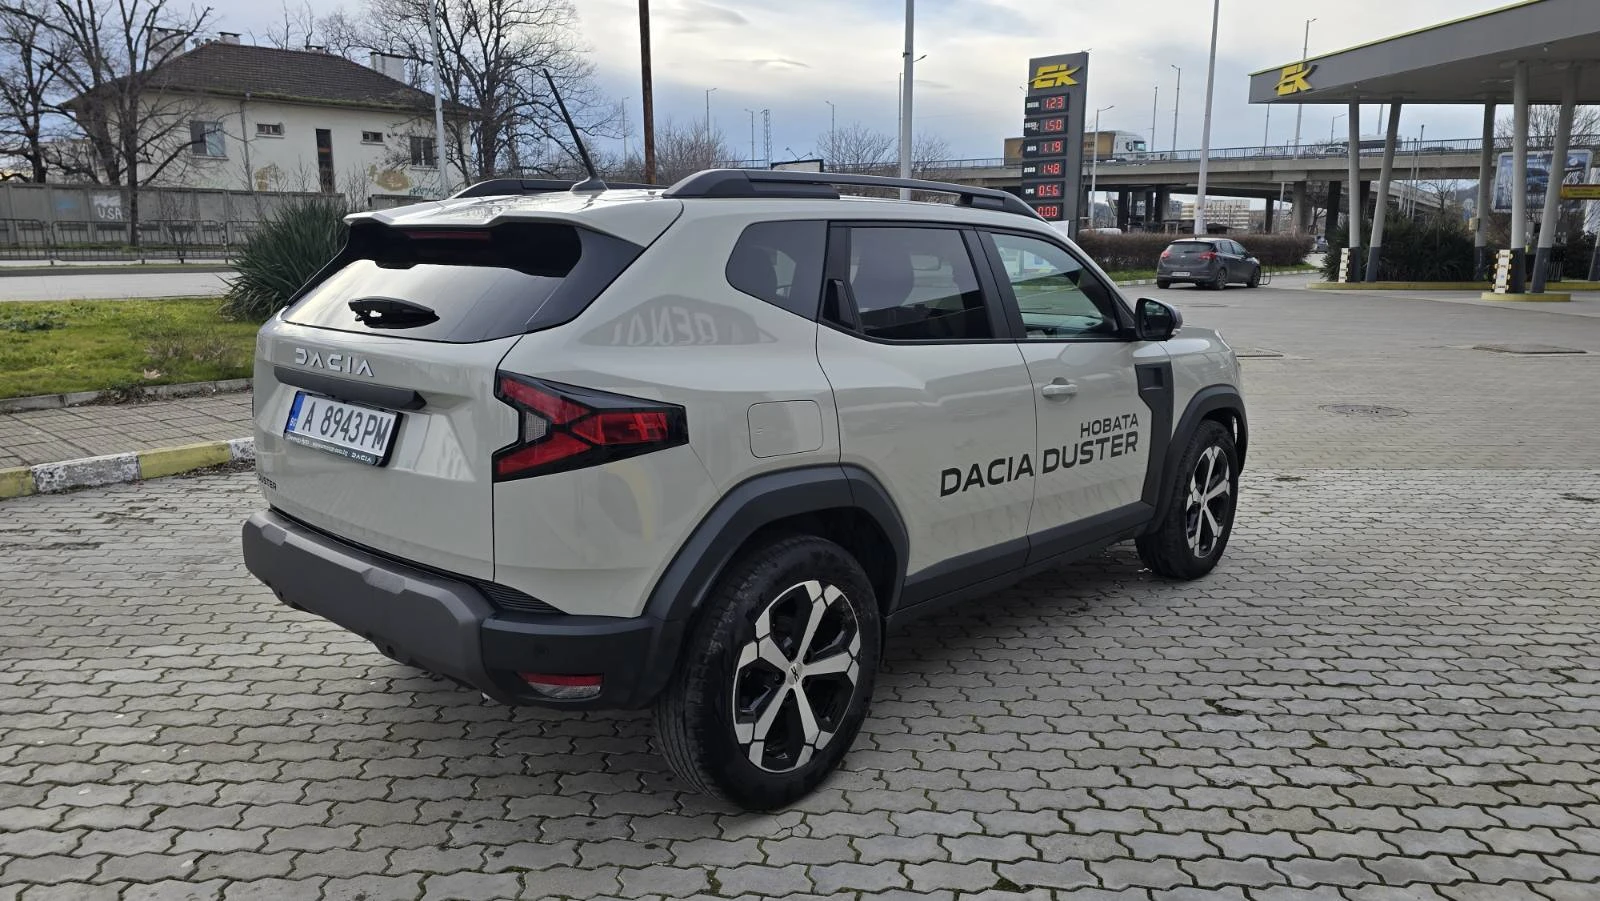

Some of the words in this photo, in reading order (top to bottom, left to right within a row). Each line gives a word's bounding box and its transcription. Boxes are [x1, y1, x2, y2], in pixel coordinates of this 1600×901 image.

[1028, 64, 1082, 89] EK
[1274, 63, 1312, 96] EK
[97, 207, 123, 220] USA
[295, 347, 374, 377] DACIA
[302, 400, 316, 432] A
[940, 453, 1034, 498] DACIA
[1042, 430, 1139, 474] DUSTER
